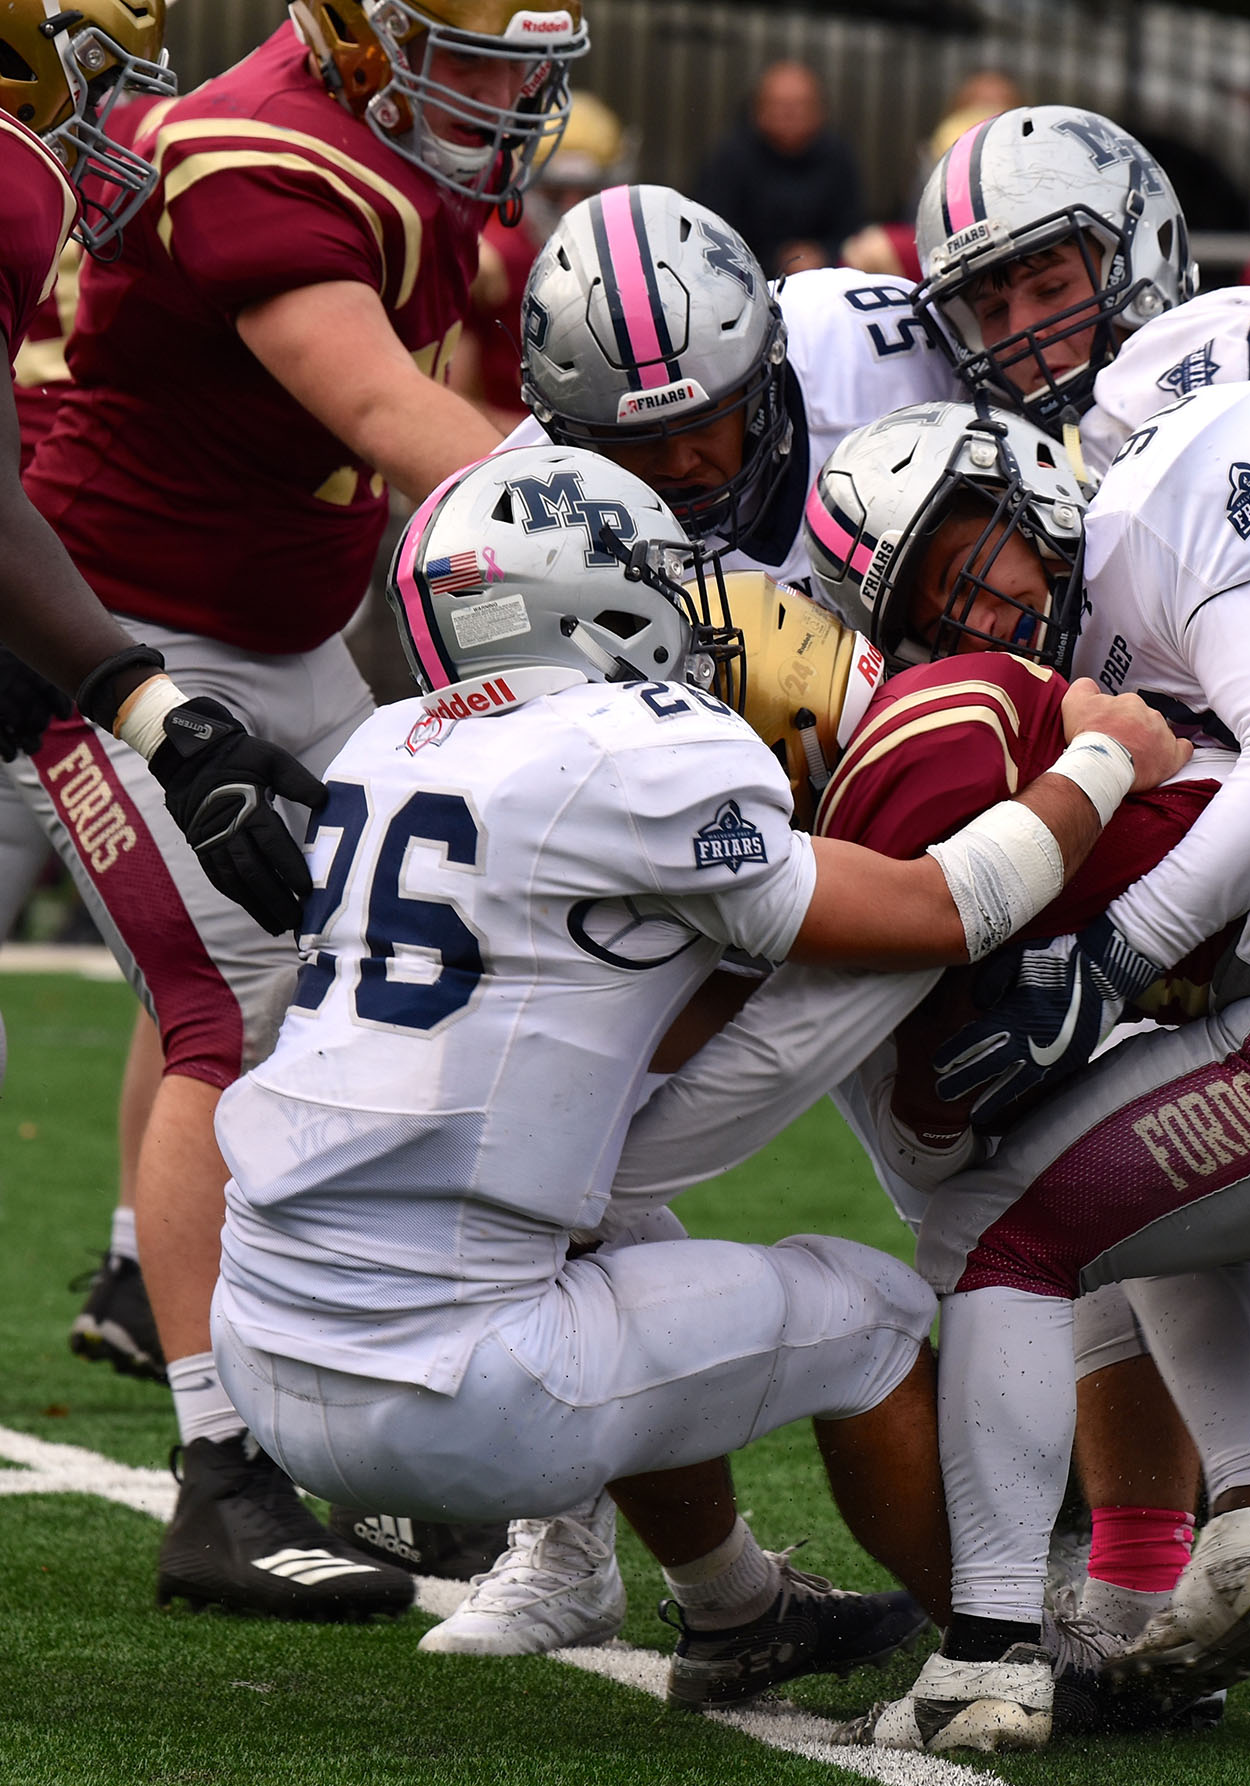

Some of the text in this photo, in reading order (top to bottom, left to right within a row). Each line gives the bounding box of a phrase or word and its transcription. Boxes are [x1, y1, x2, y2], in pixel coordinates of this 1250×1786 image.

[522, 19, 569, 33] Riddell
[946, 225, 988, 255] FRIARS
[637, 388, 687, 411] FRIARS
[504, 470, 638, 569] MP
[862, 540, 896, 602] FRIARS
[1099, 634, 1134, 697] PREP
[47, 741, 138, 874] FORDS
[698, 836, 762, 859] FRIARS
[288, 778, 488, 1034] 26
[353, 1521, 422, 1563] adidas
